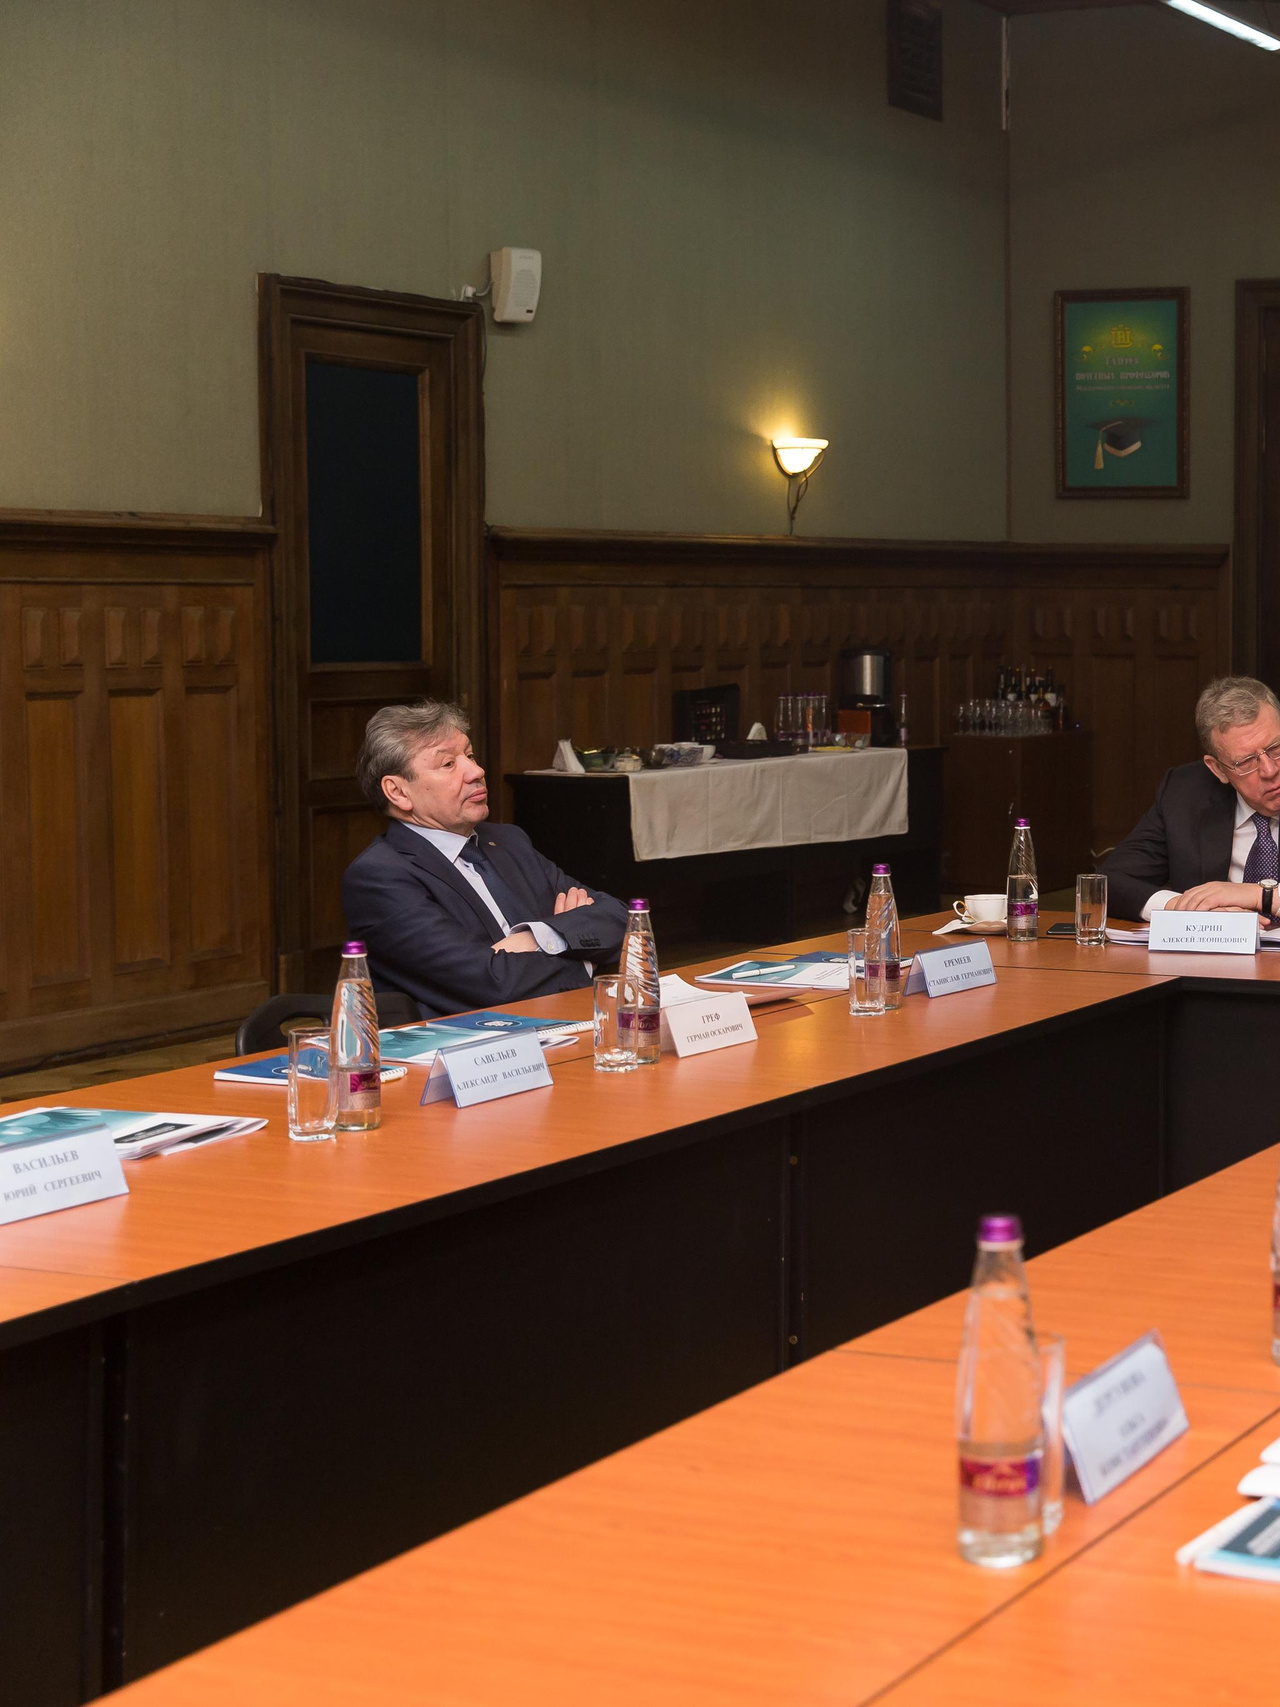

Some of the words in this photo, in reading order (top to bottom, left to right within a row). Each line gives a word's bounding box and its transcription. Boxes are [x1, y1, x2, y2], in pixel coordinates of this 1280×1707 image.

[1185, 924, 1223, 932] КУДРИН
[944, 956, 972, 968] ЕРЕМЕЕВ
[701, 1012, 721, 1024] ГРЕФ
[686, 1031, 710, 1043] ГЕРМАН
[709, 1023, 744, 1038] ОСКАРОВИЧ
[473, 1048, 518, 1067] САВЕЛЬЕВ
[456, 1073, 499, 1091] АЛЕКСАНДР
[502, 1062, 546, 1080] ВАСИЛЬЕВИЧ
[12, 1149, 79, 1175] ВАСИЛЬЕВ
[3, 1183, 38, 1202] ЮРИЙ
[43, 1170, 103, 1192] СЕРГЕЕВИЧ
